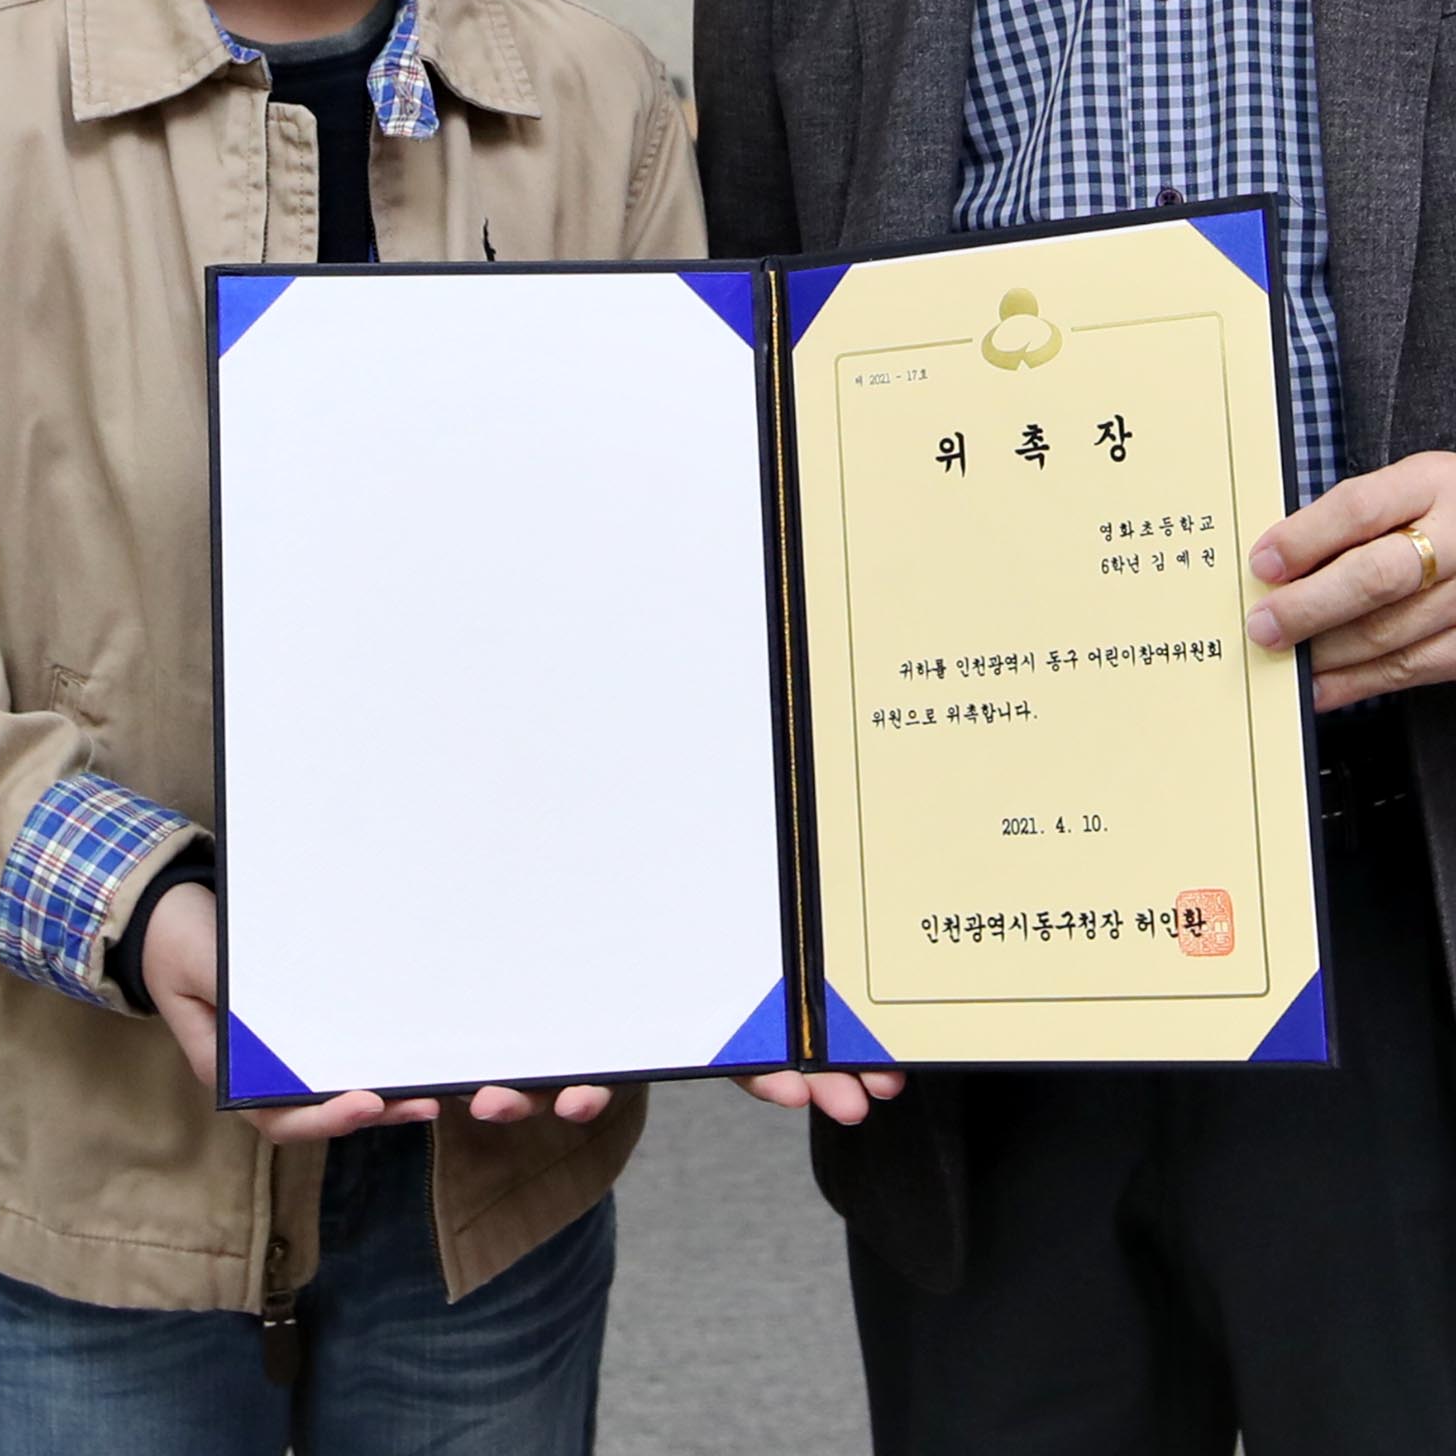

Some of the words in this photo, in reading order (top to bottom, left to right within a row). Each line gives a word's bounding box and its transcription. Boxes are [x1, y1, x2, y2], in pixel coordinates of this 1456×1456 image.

[869, 373, 891, 385] 2021
[1099, 514, 1215, 543] 영화초등학교
[1101, 553, 1140, 575] 6학년
[898, 658, 947, 681] 귀하를
[956, 651, 1036, 678] 인천광역시
[1045, 649, 1079, 673] 동구
[1087, 638, 1222, 669] 어린이참여위원회
[871, 707, 938, 731] 위원으로
[946, 700, 1038, 725] 위촉합니다.
[1001, 817, 1045, 836] 2021.
[1055, 816, 1072, 834] 4.
[1082, 814, 1108, 833] 10.
[920, 908, 1124, 944] 인천광역시동구청장
[1134, 906, 1208, 939] 허인환
